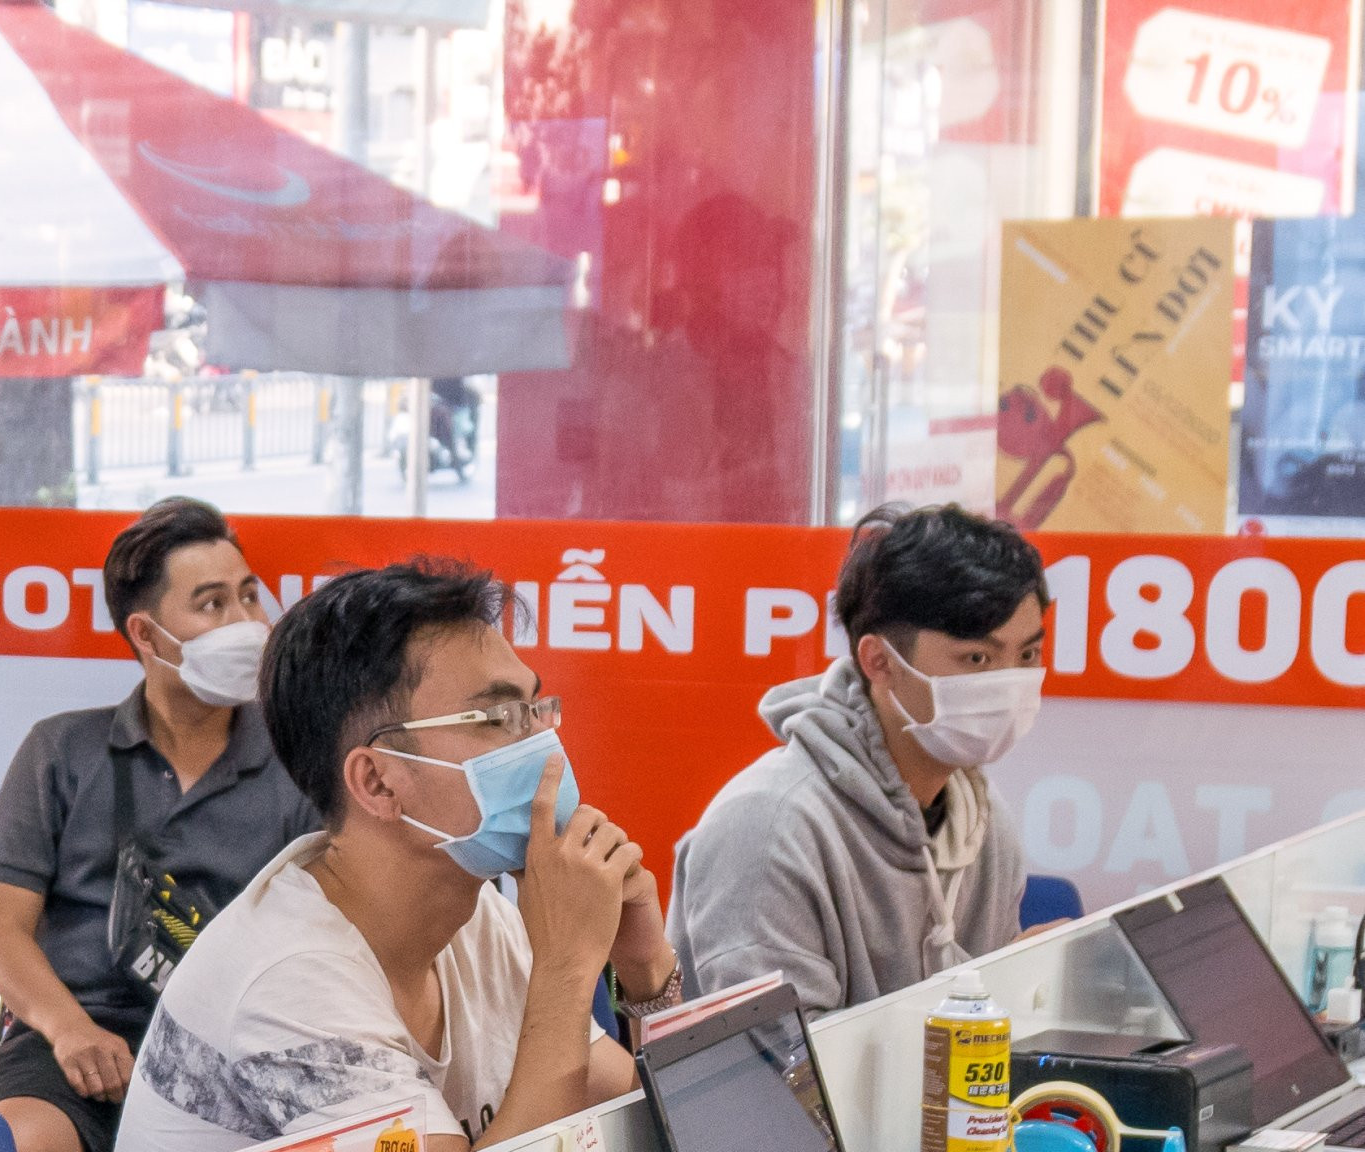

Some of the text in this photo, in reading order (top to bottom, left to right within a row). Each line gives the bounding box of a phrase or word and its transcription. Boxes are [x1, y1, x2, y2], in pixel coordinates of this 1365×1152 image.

[1185, 51, 1296, 126] 10%
[490, 549, 694, 653] IỄN
[965, 1063, 1004, 1082] 530
